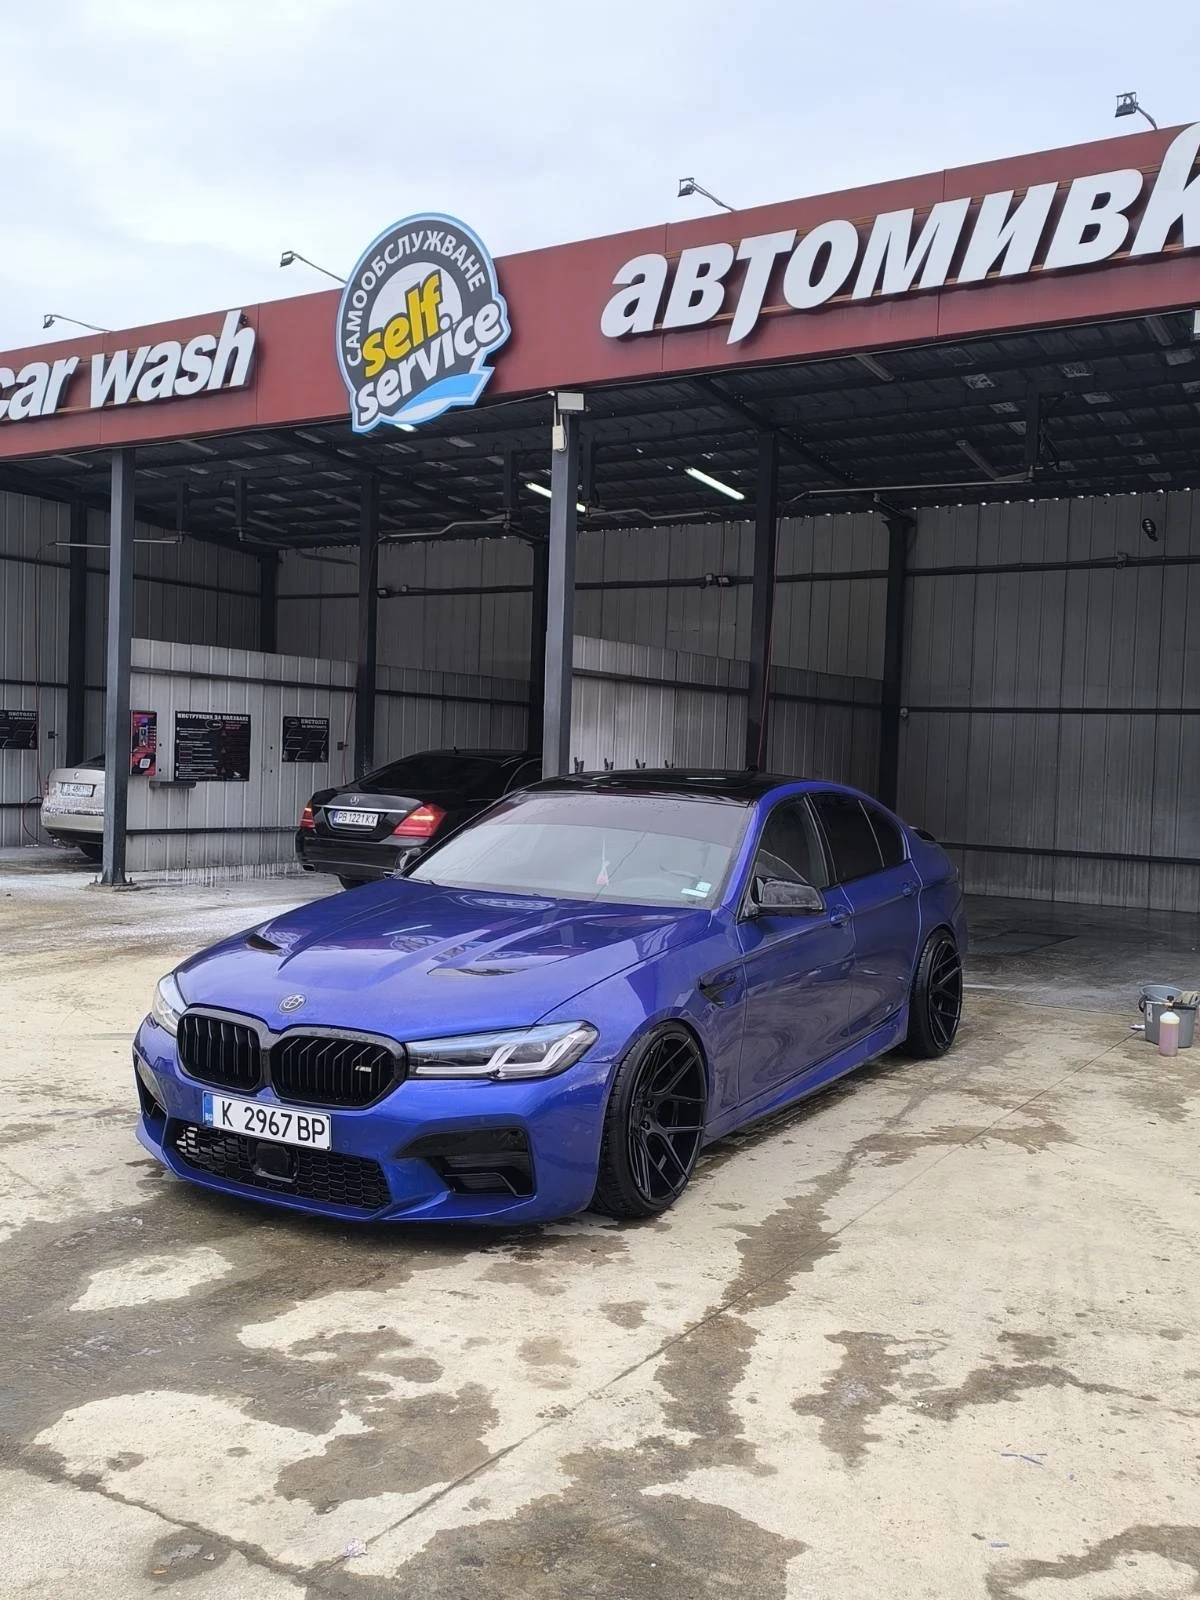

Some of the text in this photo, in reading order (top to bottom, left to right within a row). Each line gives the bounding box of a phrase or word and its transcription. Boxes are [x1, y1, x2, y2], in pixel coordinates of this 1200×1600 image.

[345, 230, 486, 367] САМООБСЛУЖВАНЕ
[362, 273, 441, 378] self
[90, 309, 256, 408] wash
[358, 303, 500, 423] service
[222, 1100, 326, 1143] K 2967 BP
